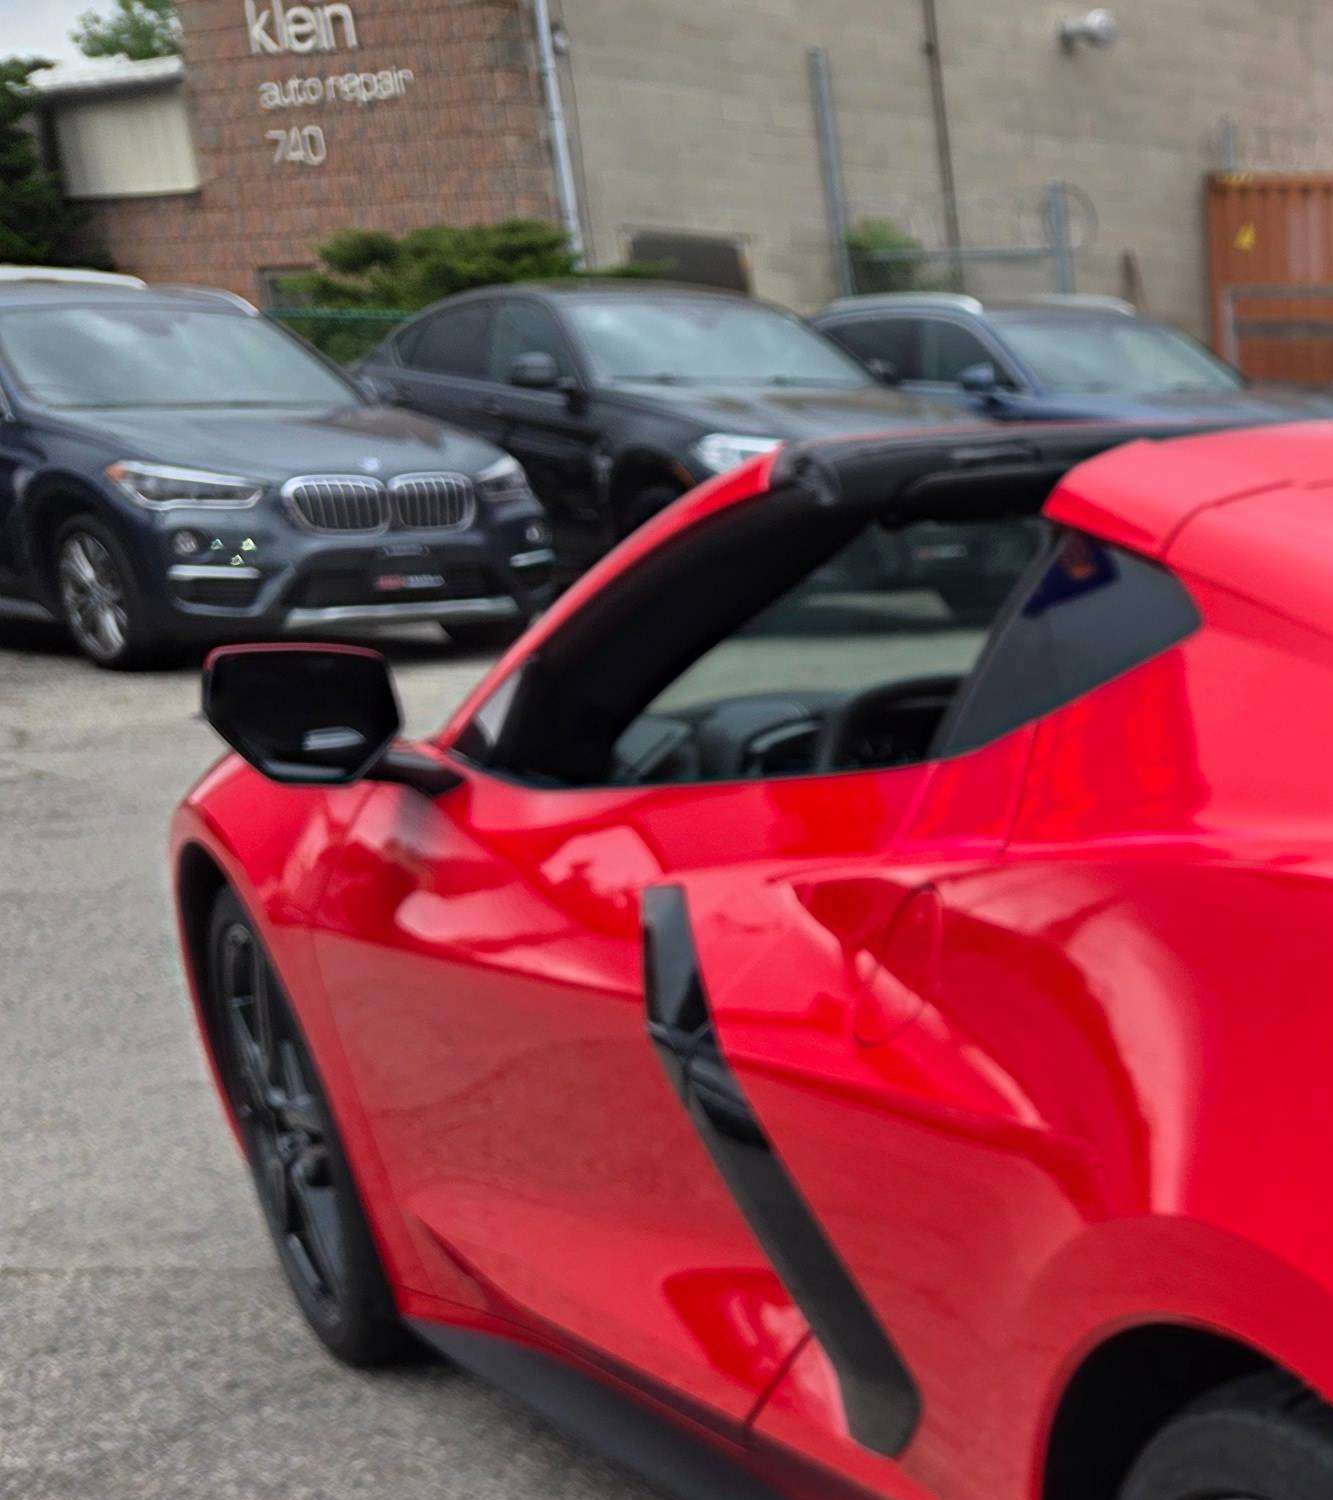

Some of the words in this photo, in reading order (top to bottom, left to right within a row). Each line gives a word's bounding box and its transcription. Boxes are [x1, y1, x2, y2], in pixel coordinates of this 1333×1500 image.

[244, 0, 358, 54] klein
[258, 76, 324, 110] auto
[326, 66, 414, 104] repair
[264, 125, 327, 166] 740
